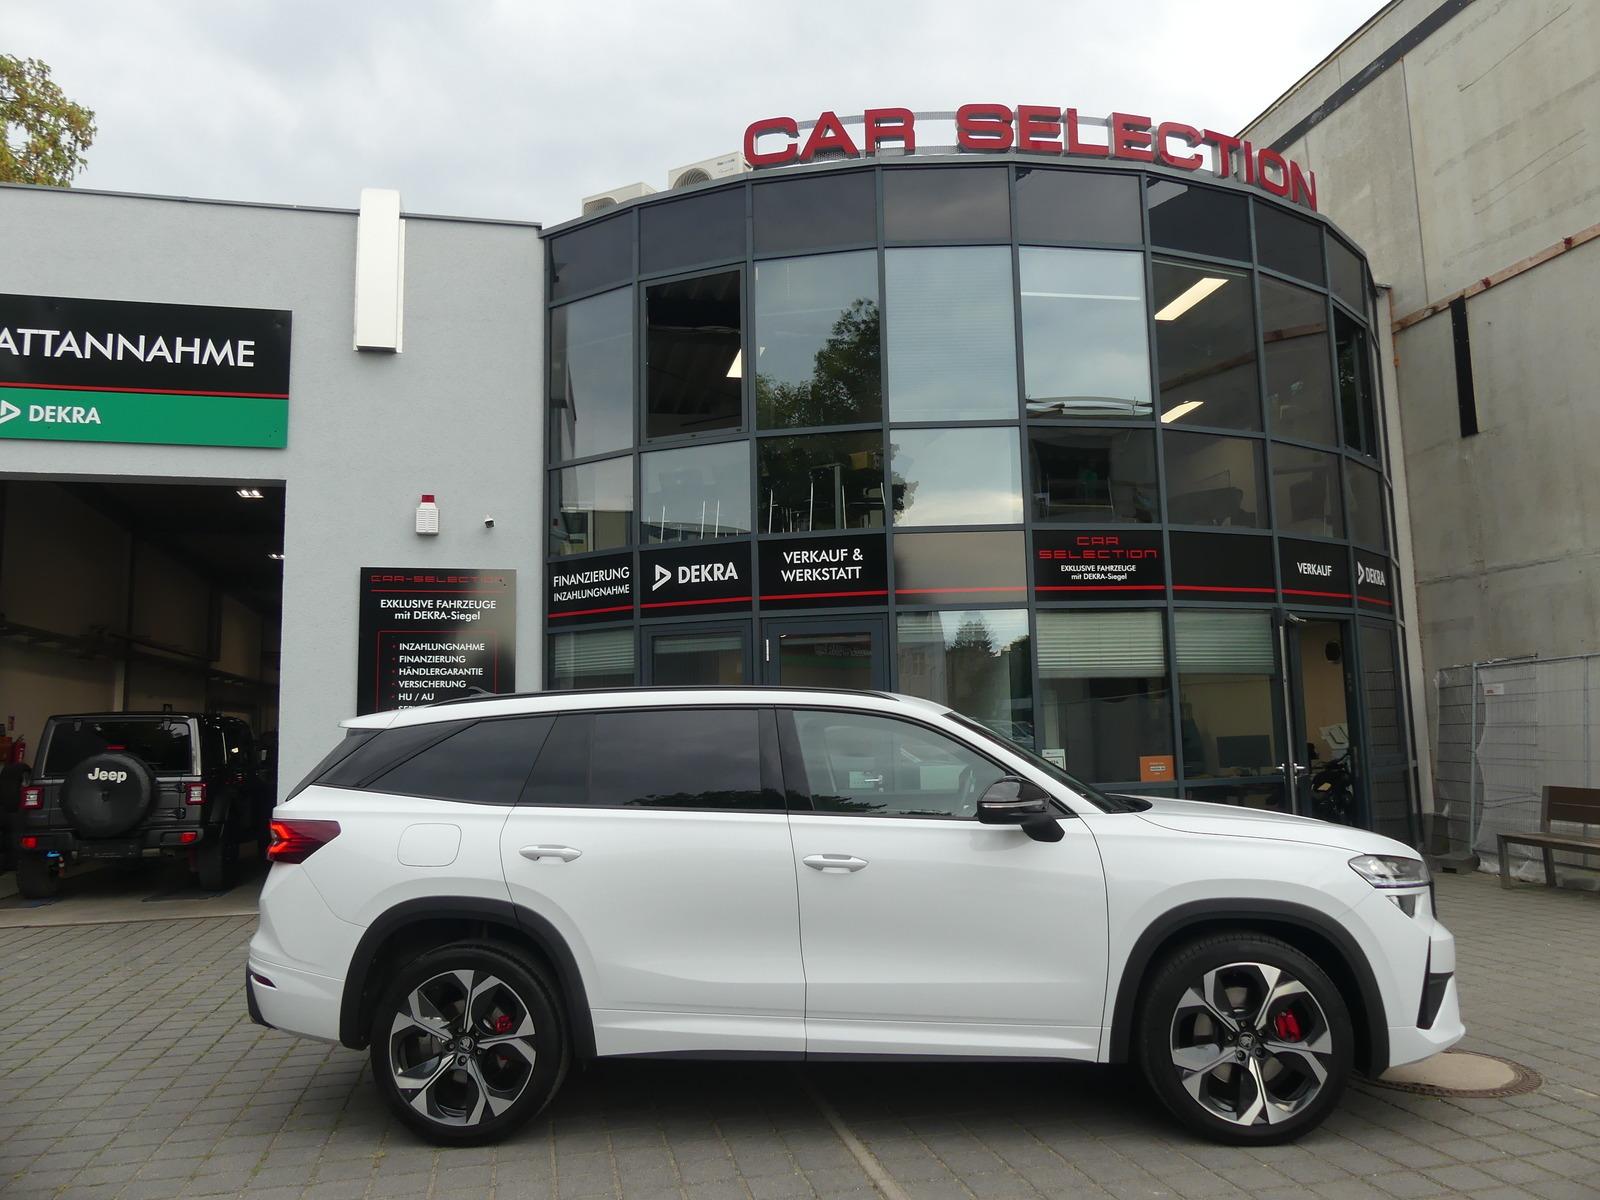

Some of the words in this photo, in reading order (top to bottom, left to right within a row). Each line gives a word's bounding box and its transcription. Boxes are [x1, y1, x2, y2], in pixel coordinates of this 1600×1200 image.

[744, 108, 915, 168] CAR
[955, 103, 1317, 211] SELECTION
[0, 327, 255, 367] ATTANNAHME
[29, 405, 101, 424] DEKRA
[1077, 537, 1119, 546] CAR
[783, 549, 848, 564] VERKAUF
[852, 548, 863, 560] &
[1039, 550, 1157, 559] SELECTION
[553, 566, 630, 588] FINANZIERUNG
[678, 561, 739, 584] DEKRA
[781, 566, 862, 582] WERKSTATT
[1083, 573, 1127, 581] DEKRA-Siegel
[1297, 562, 1332, 577] VERKAUF
[1365, 567, 1386, 586] DEKRA
[553, 584, 630, 602] INZAHLUNGNAHME
[380, 599, 433, 609] EXKLUSIVE
[436, 600, 496, 609] FAHRZEUGE
[394, 611, 411, 620] mit
[413, 611, 481, 622] DEKRA-Siegel
[399, 643, 485, 651] INZAHLUNGNAHME
[399, 655, 466, 663] FINANZIERUNG
[398, 666, 483, 676] HÄNDLERGARANTIE
[398, 680, 467, 688] VERSICHERUNG
[398, 693, 412, 701] HU
[414, 693, 420, 701] /
[421, 693, 435, 701] AU
[88, 767, 127, 784] Jeep
